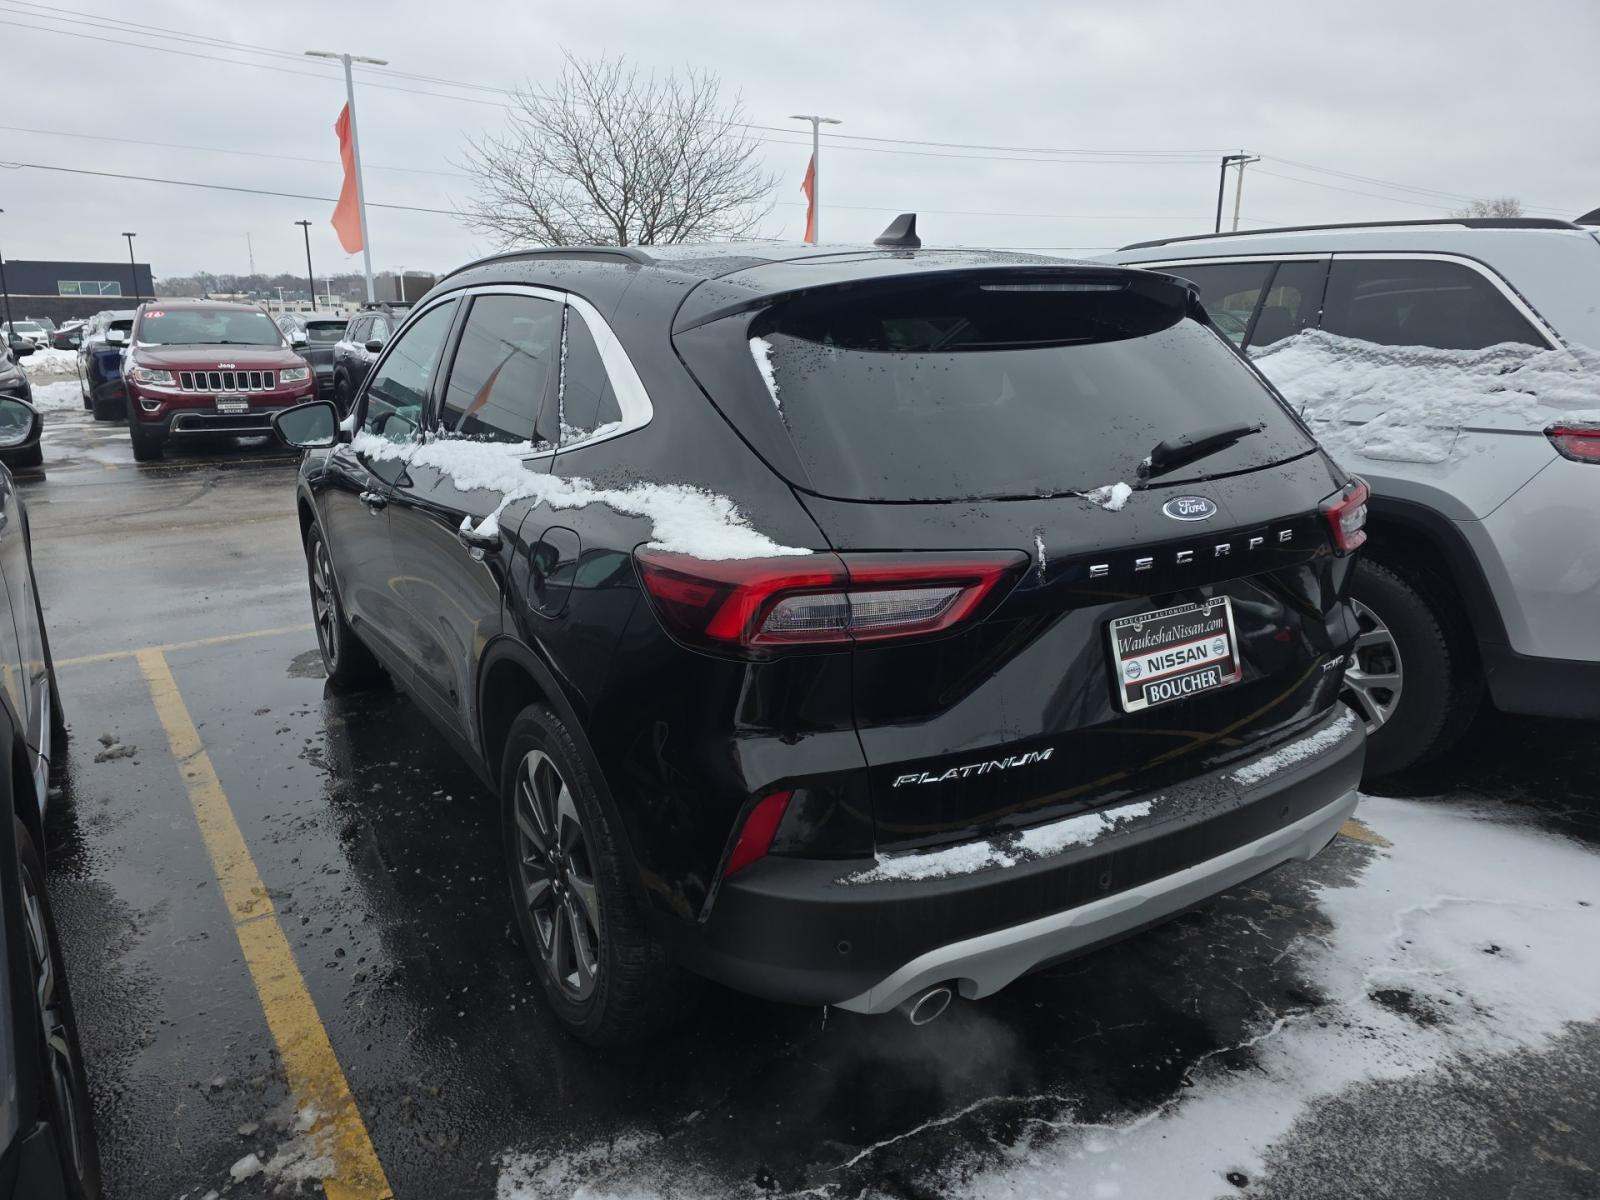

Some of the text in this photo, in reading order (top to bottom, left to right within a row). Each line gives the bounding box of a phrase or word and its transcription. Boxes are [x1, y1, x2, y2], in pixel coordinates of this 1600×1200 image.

[1178, 499, 1207, 514] Ford
[1089, 529, 1293, 578] ESCAPE
[1119, 617, 1224, 655] WaukeshaNissan.com
[1147, 644, 1209, 673] NISSAN
[1149, 670, 1218, 703] BOUCHER
[893, 748, 1054, 788] PLATINUM
